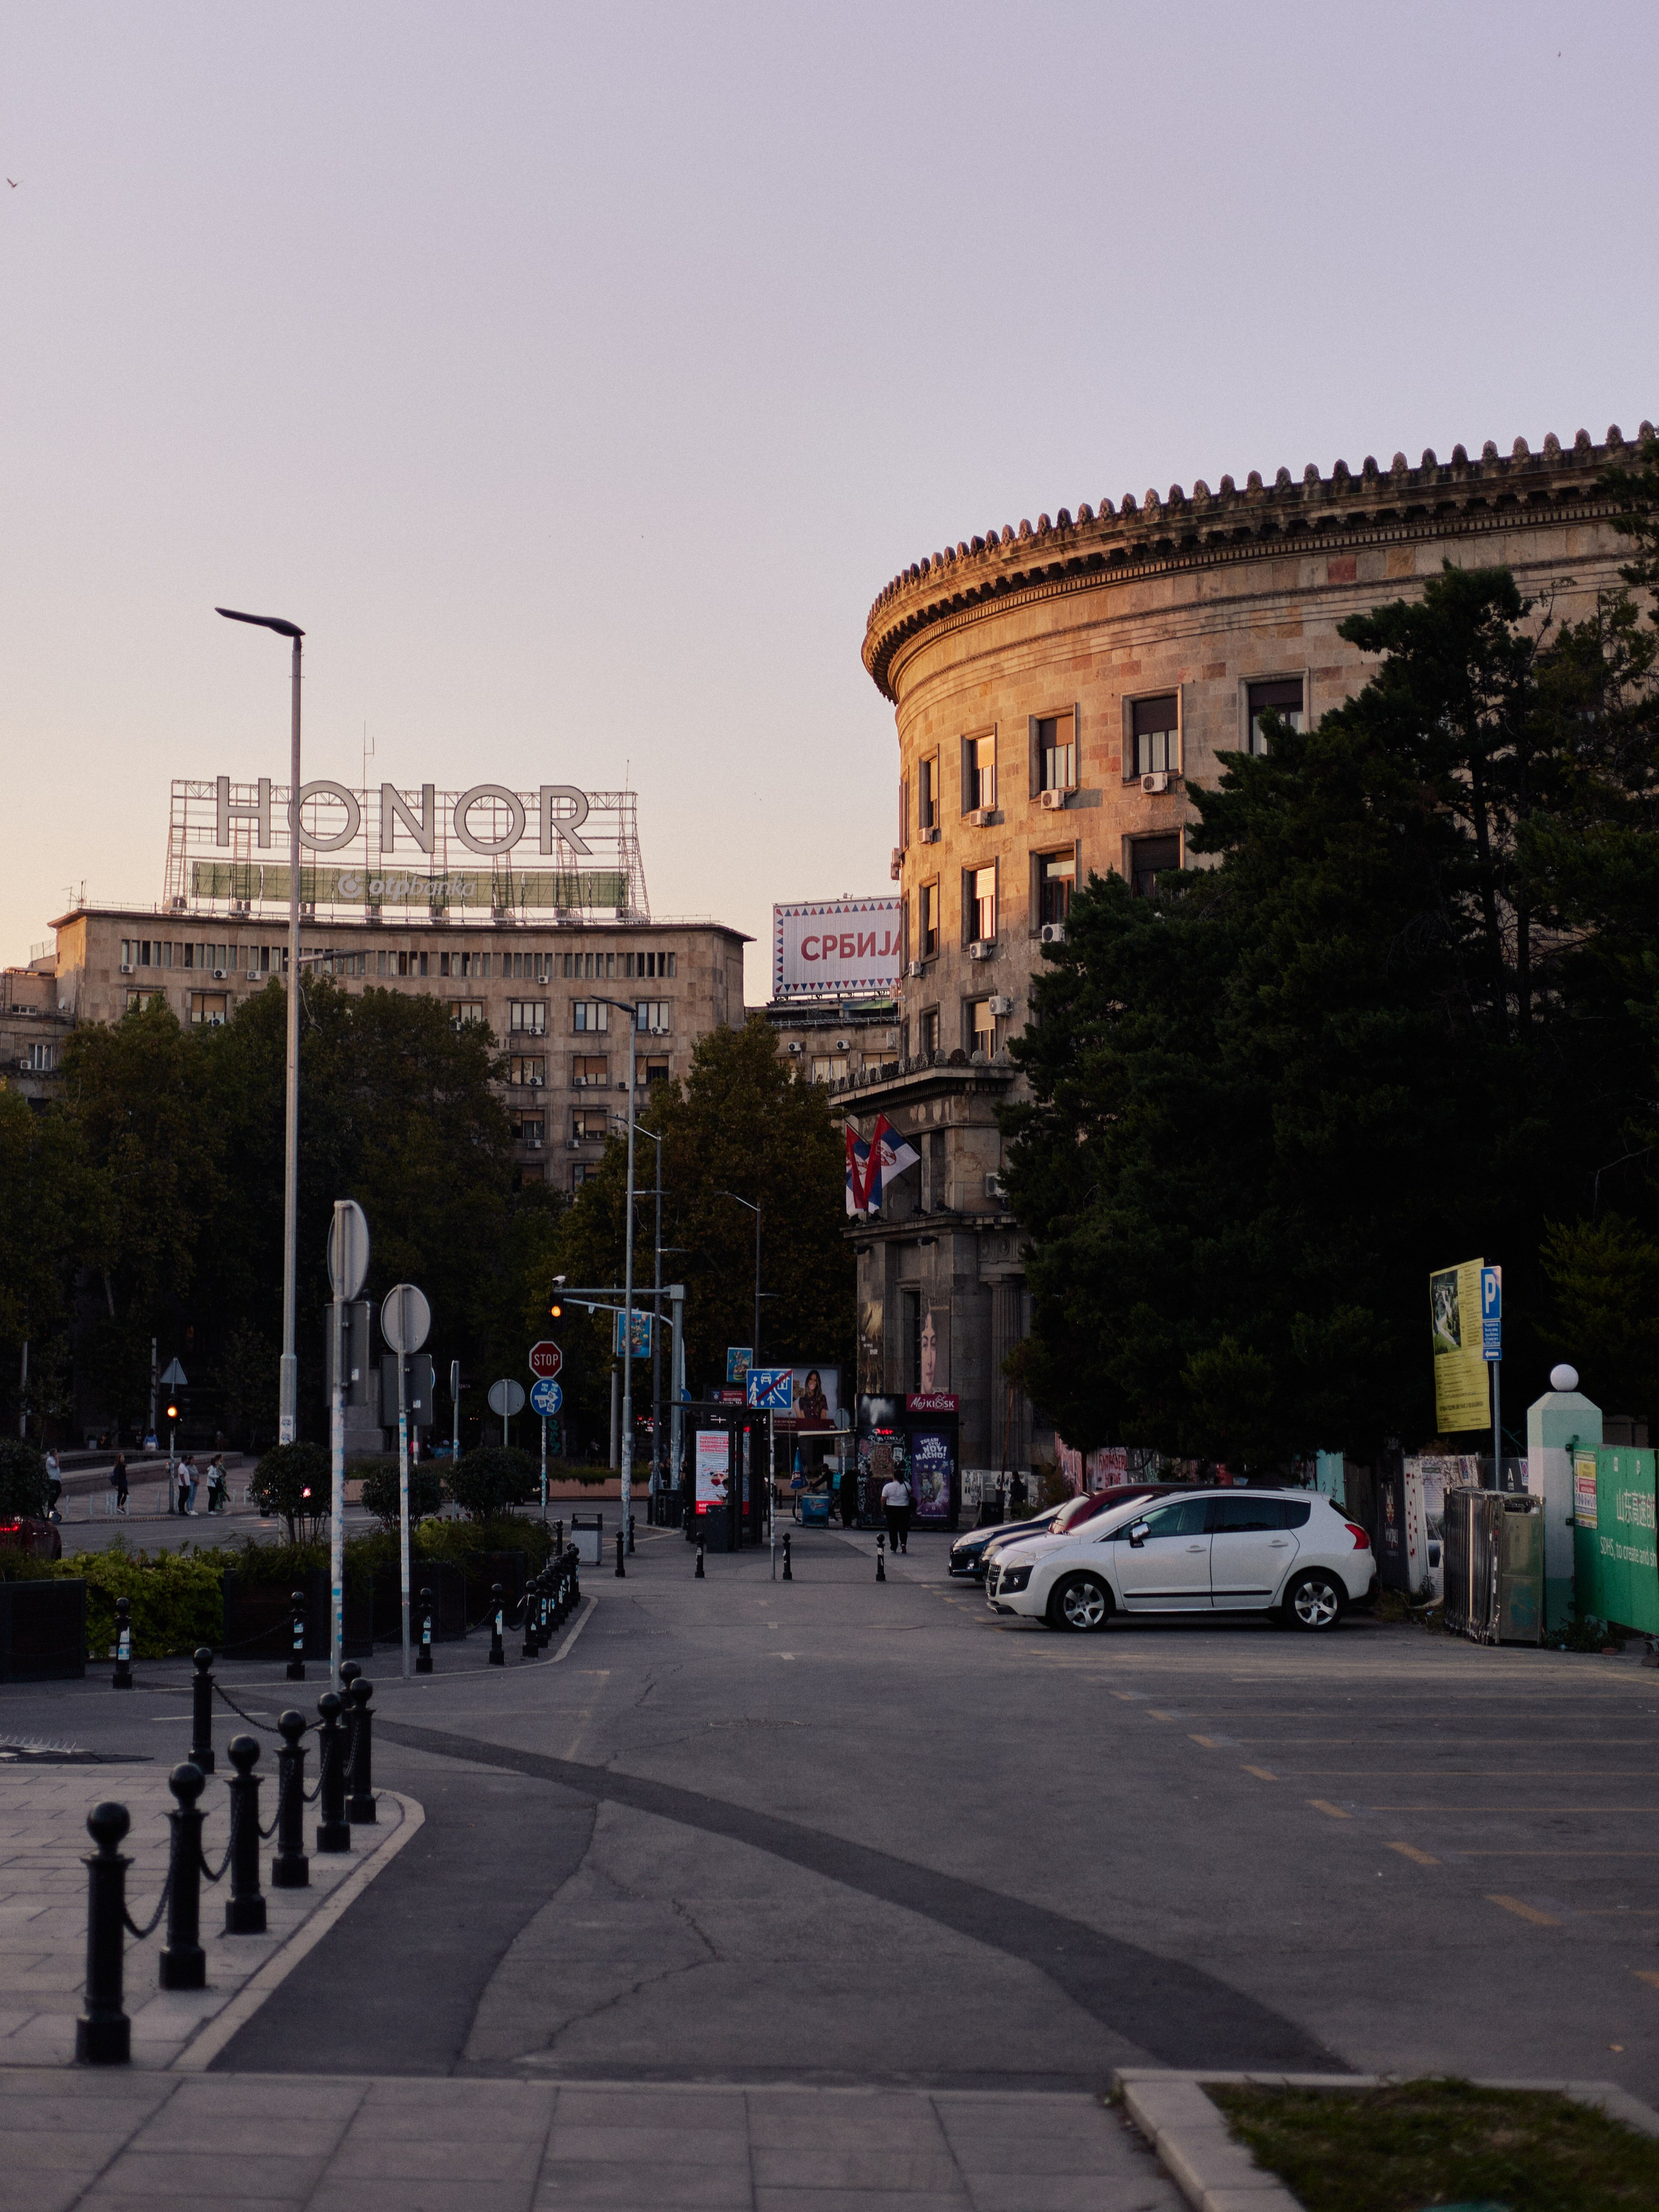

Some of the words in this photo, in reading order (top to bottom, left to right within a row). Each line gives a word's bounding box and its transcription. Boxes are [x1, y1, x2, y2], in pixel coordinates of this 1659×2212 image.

[216, 776, 592, 855] HONOR
[1485, 1274, 1496, 1314] P
[534, 1354, 559, 1366] STOP
[911, 1397, 925, 1410] Moj
[915, 1452, 946, 1461] MACHO!
[1600, 1536, 1616, 1560] SDHS,
[1616, 1541, 1622, 1559] to
[1623, 1545, 1639, 1563] create
[1640, 1546, 1649, 1565] and
